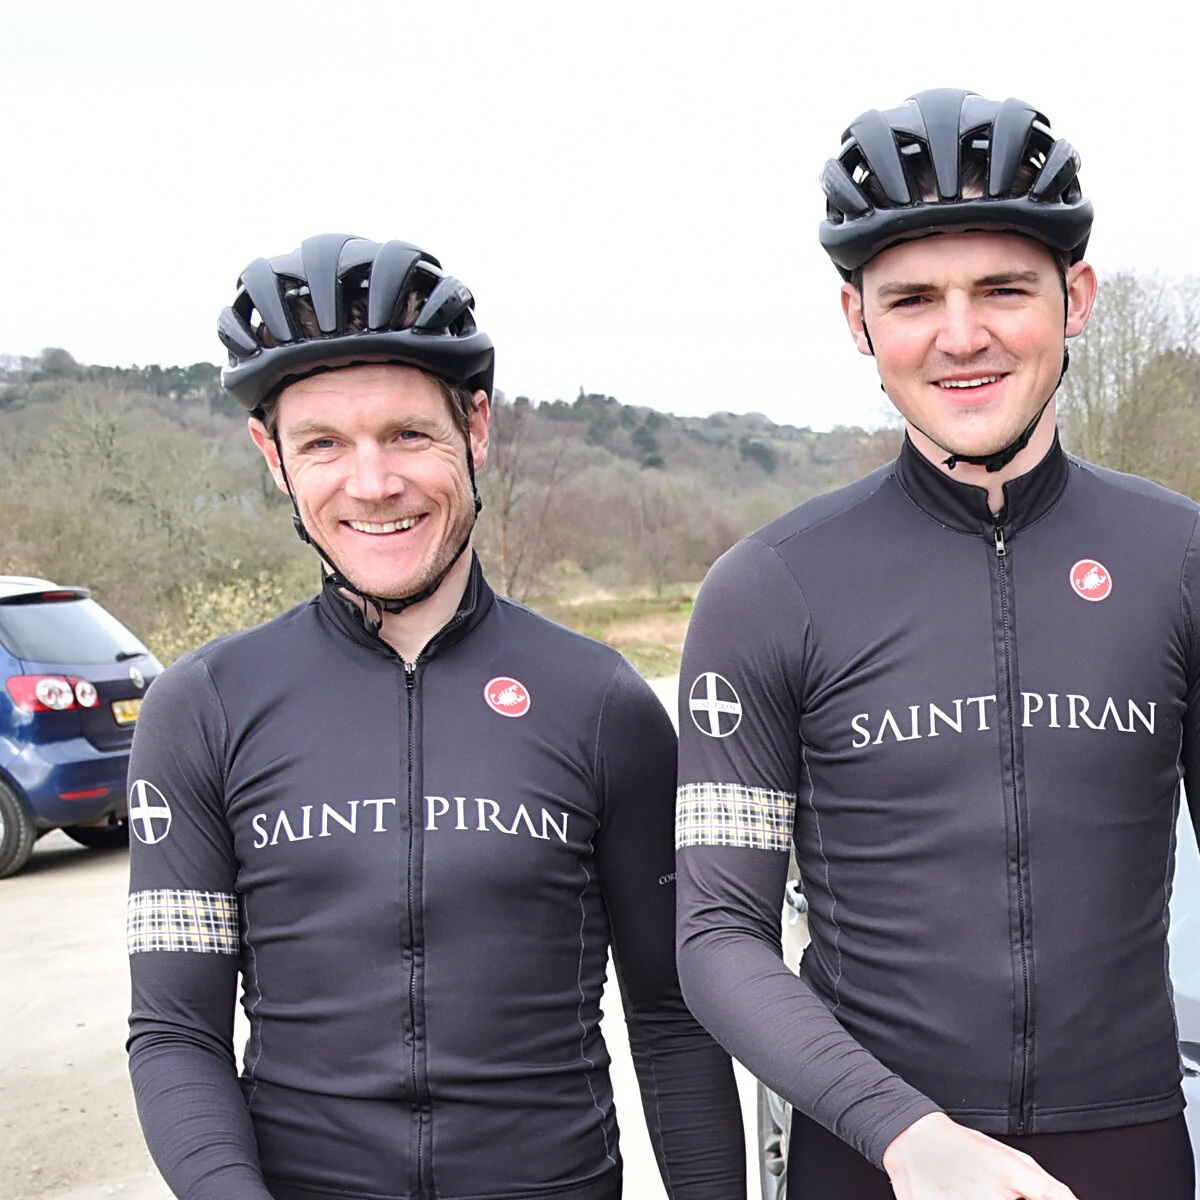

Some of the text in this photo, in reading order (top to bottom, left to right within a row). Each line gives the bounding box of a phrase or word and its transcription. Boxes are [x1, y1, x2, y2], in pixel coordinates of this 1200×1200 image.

[851, 691, 1157, 748] SAINT PIRAN
[252, 796, 569, 849] SAINT PIRAN
